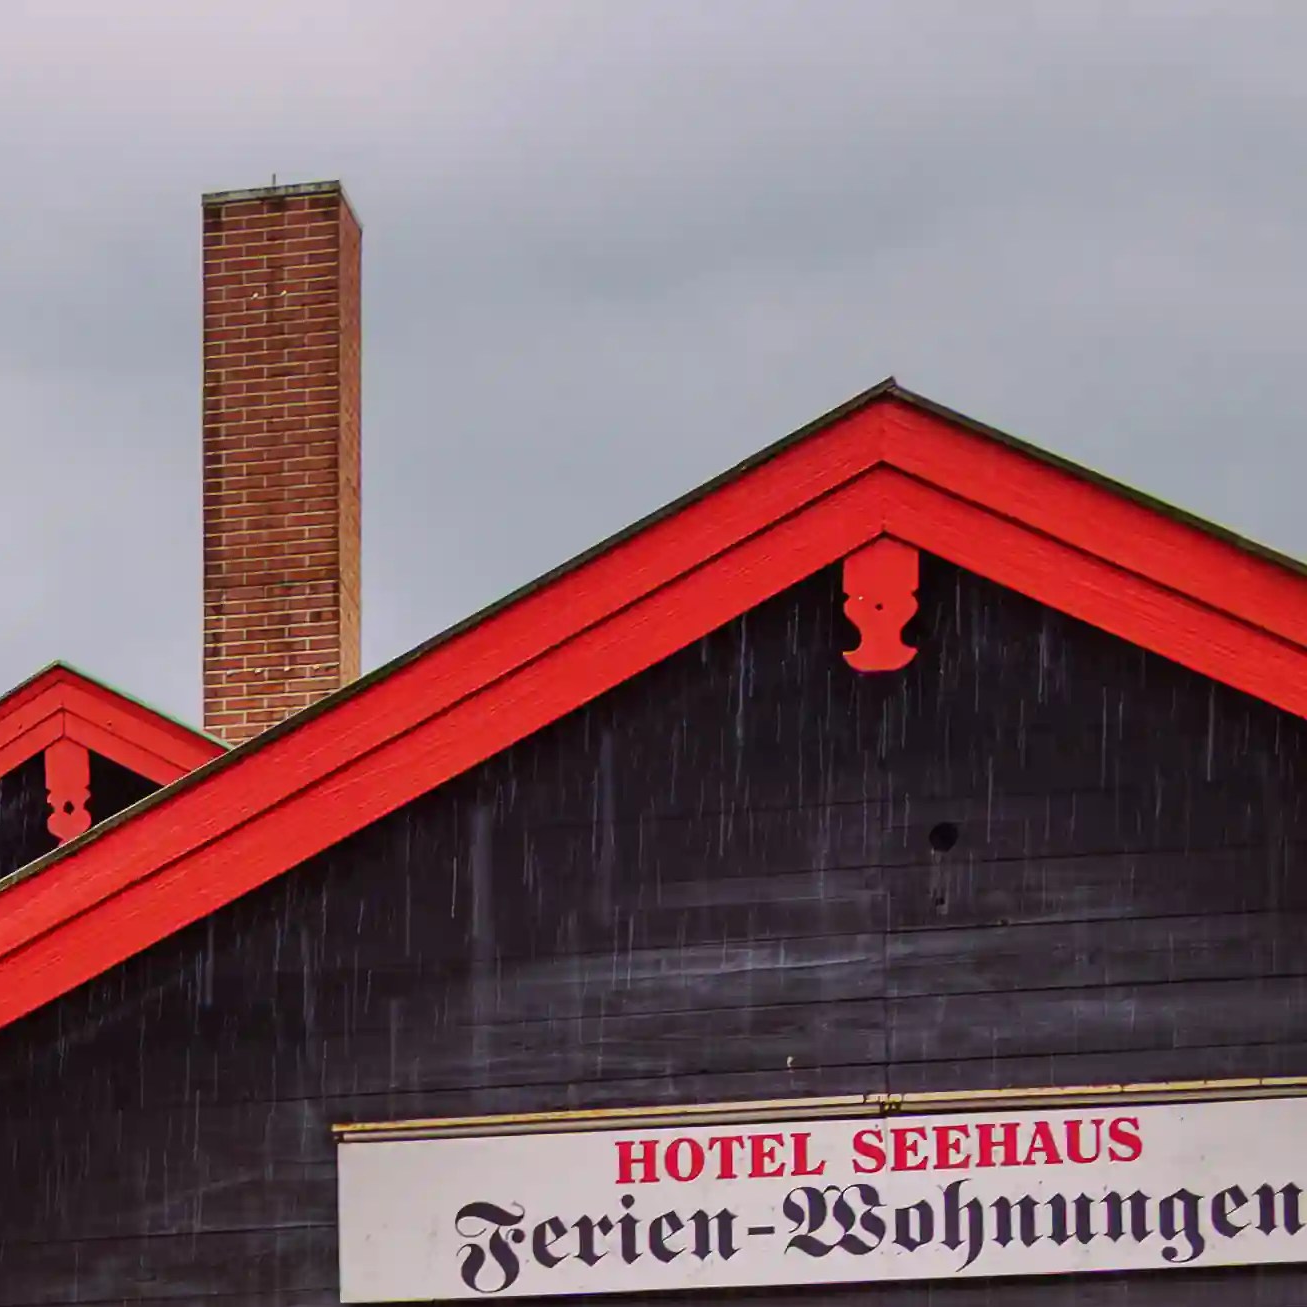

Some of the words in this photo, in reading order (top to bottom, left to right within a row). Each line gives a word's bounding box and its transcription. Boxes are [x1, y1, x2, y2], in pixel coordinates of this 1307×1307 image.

[614, 1131, 827, 1185] HOTEL
[849, 1116, 1145, 1176] SEEHAUS
[454, 1175, 1307, 1294] Ferien-Wohnungen
